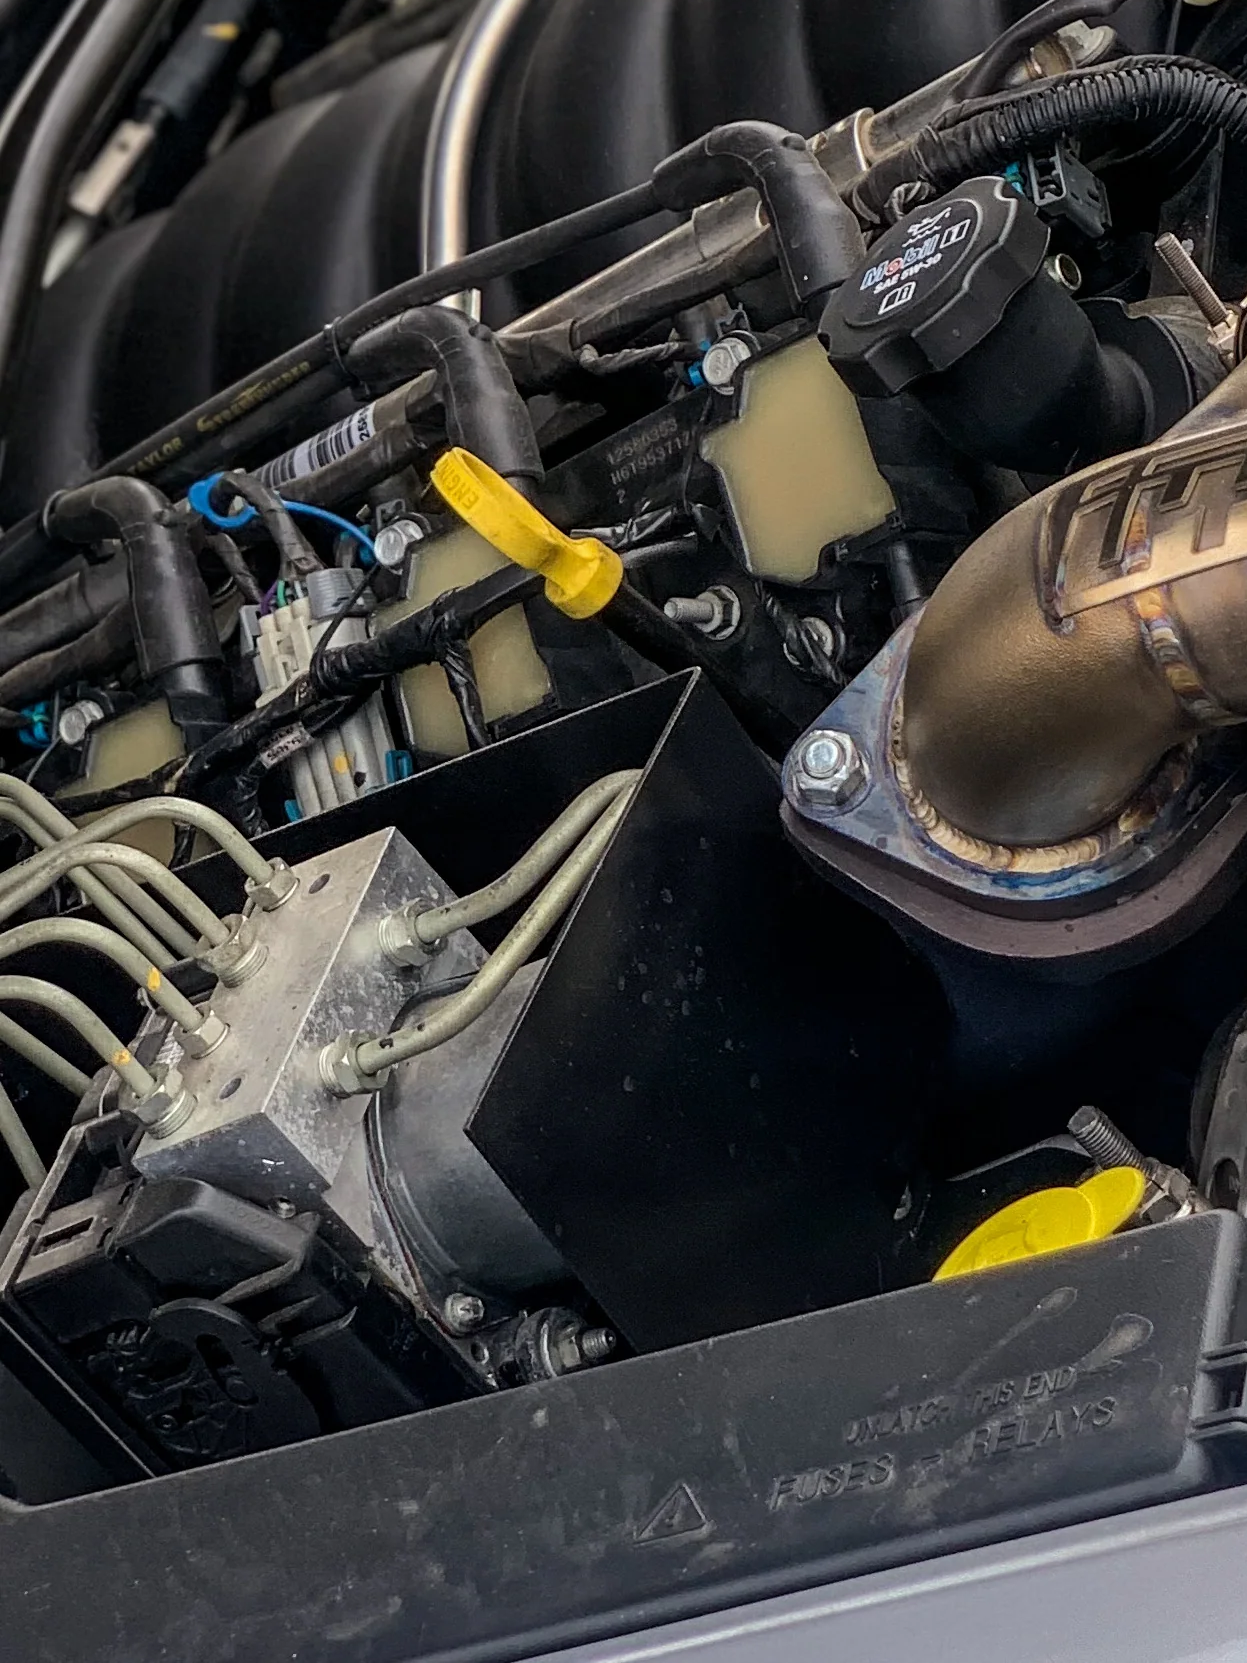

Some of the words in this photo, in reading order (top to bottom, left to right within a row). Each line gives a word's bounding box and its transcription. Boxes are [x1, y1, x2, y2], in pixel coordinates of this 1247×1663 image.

[860, 234, 940, 291] Mobil
[873, 275, 900, 294] SAE
[901, 252, 943, 280] 5W-30
[1024, 1366, 1077, 1403] END
[769, 1452, 896, 1510] FUSES
[968, 1395, 1118, 1459] RELAYS
